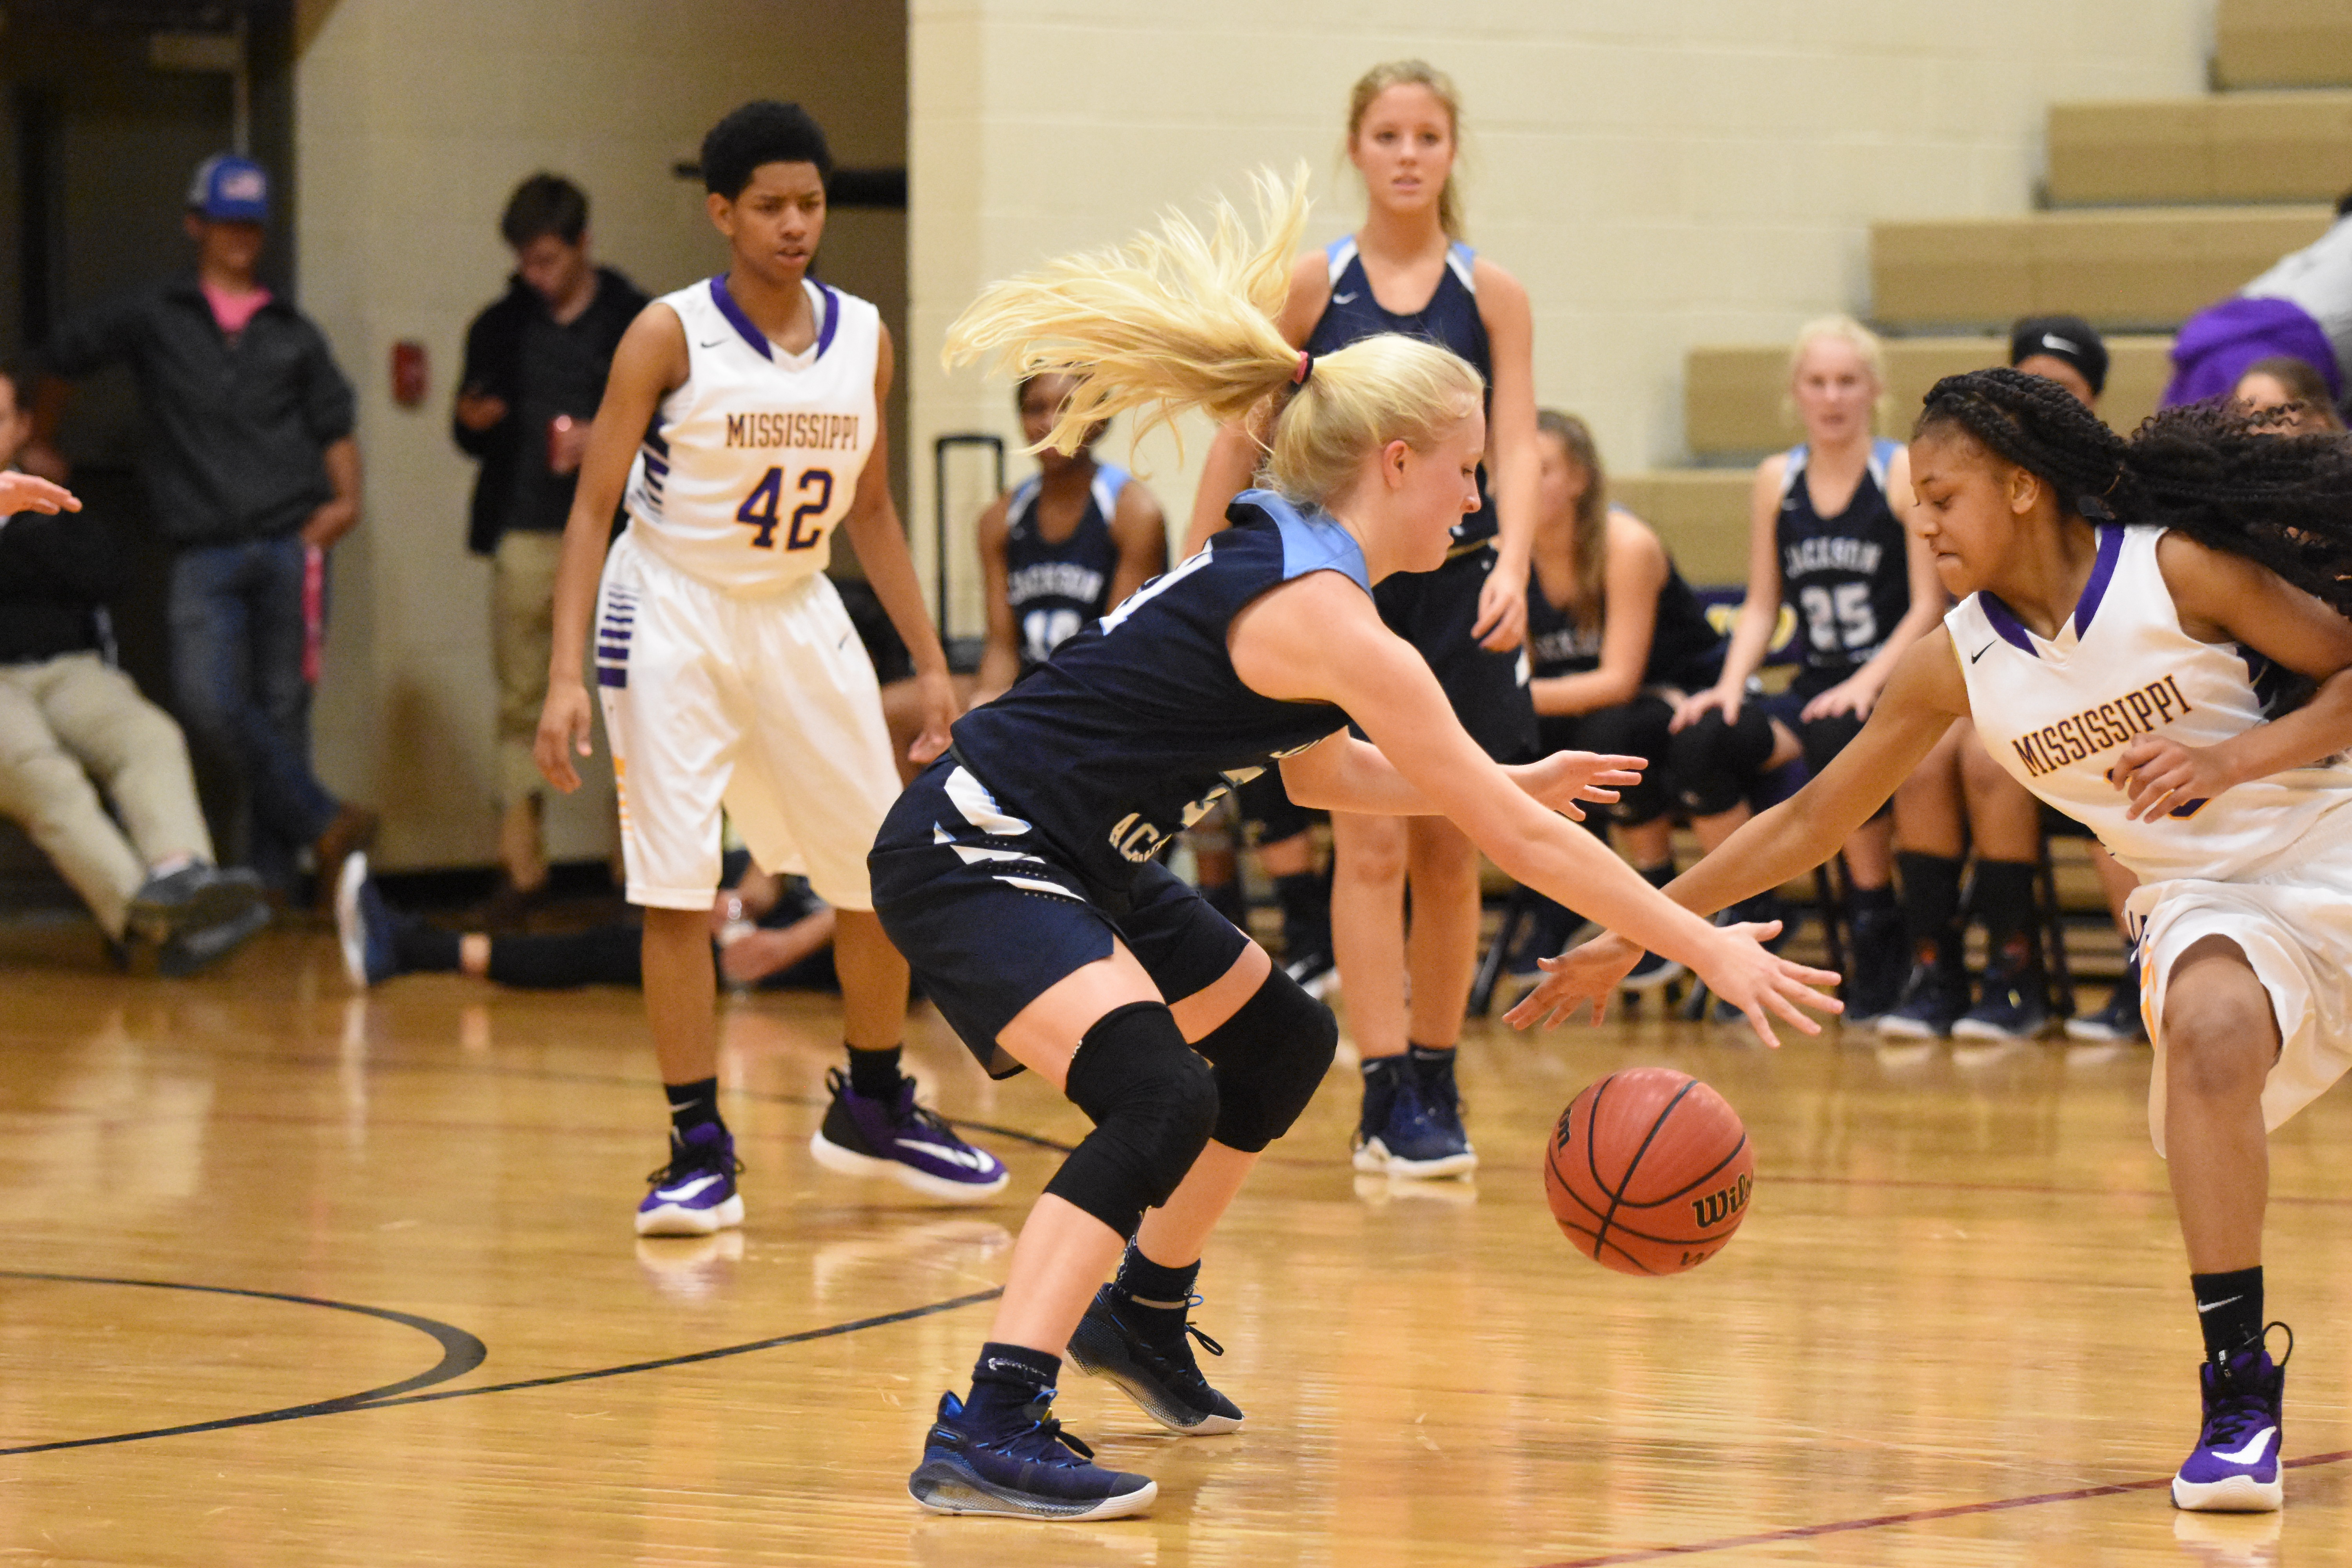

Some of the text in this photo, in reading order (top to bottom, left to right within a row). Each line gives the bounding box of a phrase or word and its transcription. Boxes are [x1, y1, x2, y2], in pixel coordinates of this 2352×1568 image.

[726, 413, 860, 450] MISSISSIPPI
[735, 466, 837, 551] 42
[1800, 582, 1877, 651] 25
[2011, 673, 2192, 777] MISSISSIPPI
